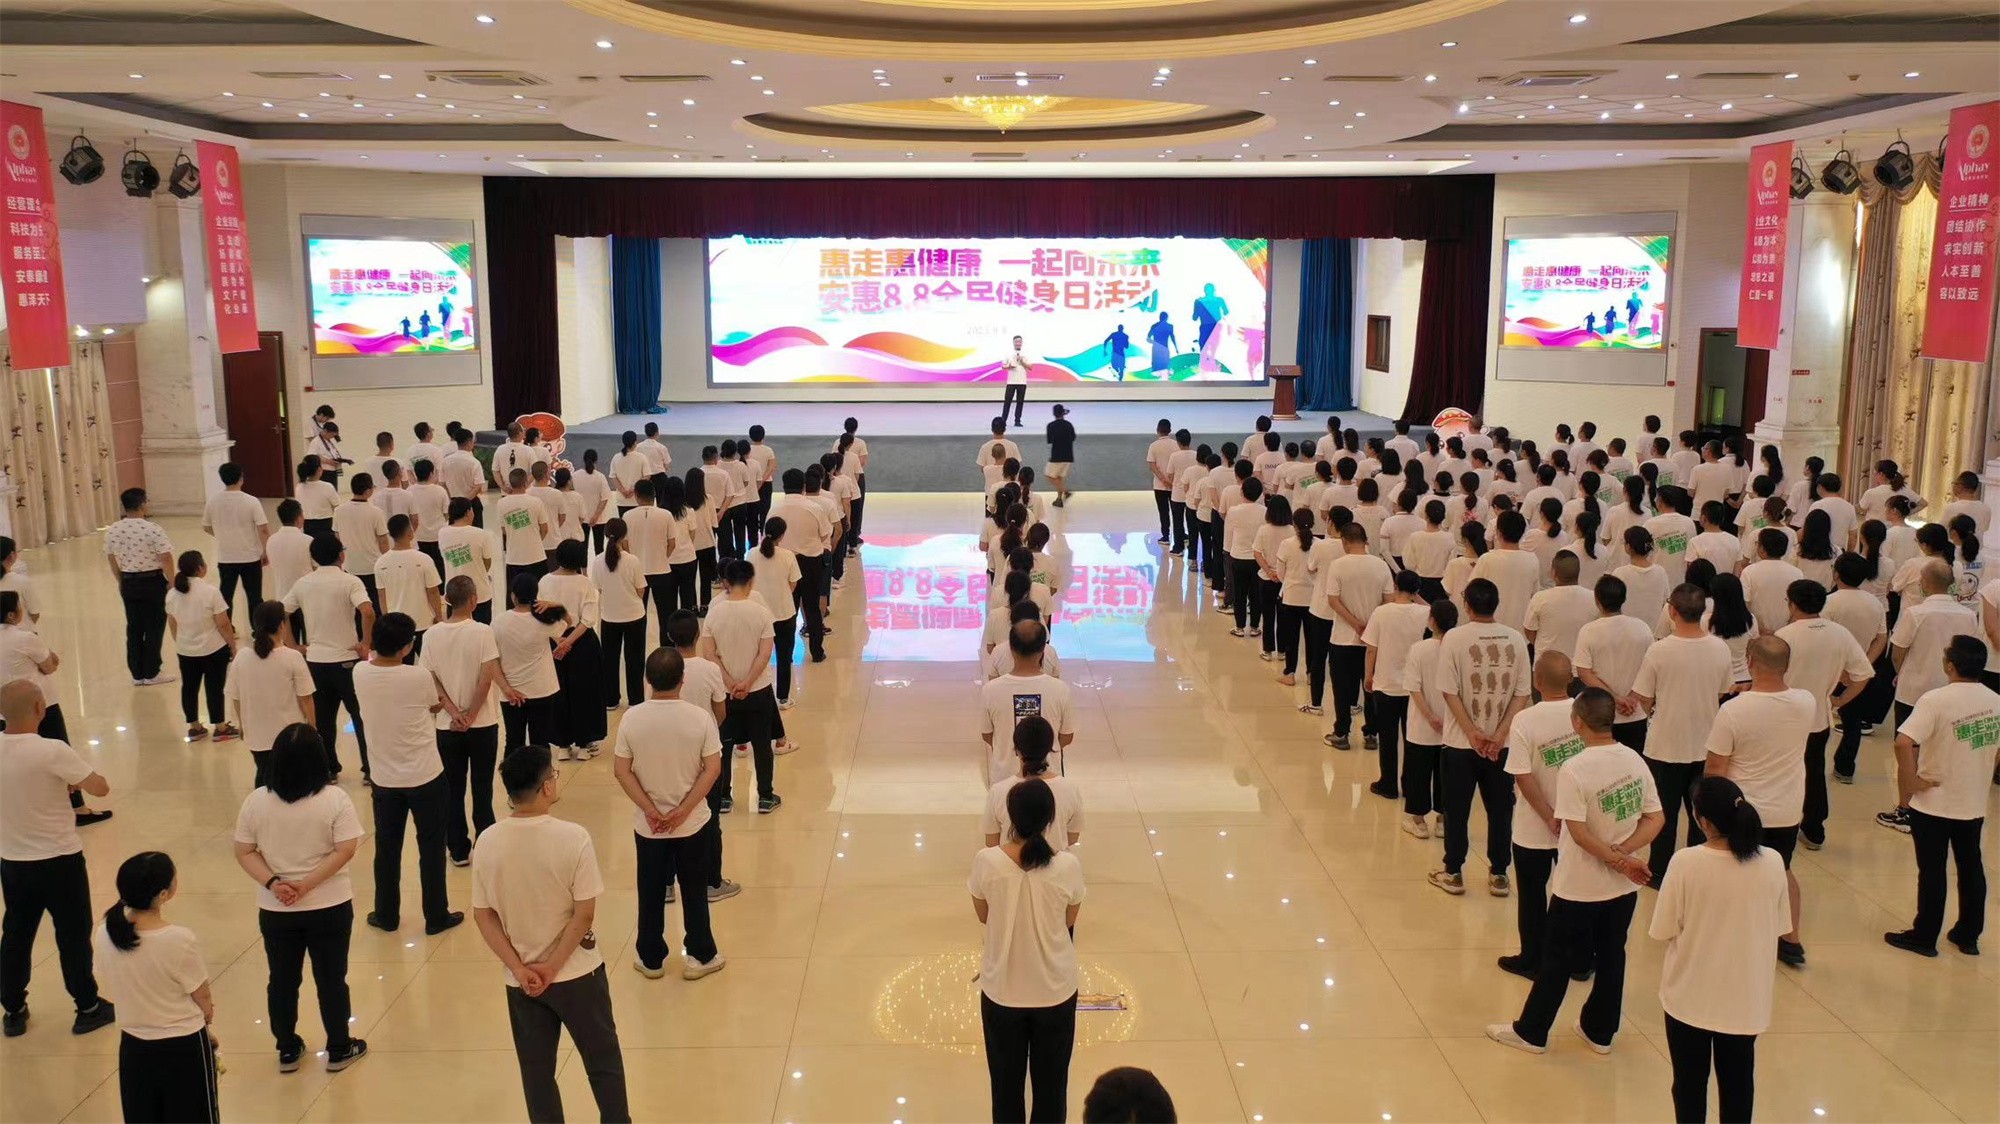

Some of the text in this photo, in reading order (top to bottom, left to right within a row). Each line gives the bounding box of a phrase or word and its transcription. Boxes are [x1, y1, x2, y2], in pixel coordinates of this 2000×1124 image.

[1949, 194, 1990, 209] 企业精神
[1946, 219, 1987, 234] 团结协作
[1943, 241, 1985, 256] 求实创新
[818, 248, 982, 277] 惠走惠健康
[1941, 263, 1982, 278] 人本至善
